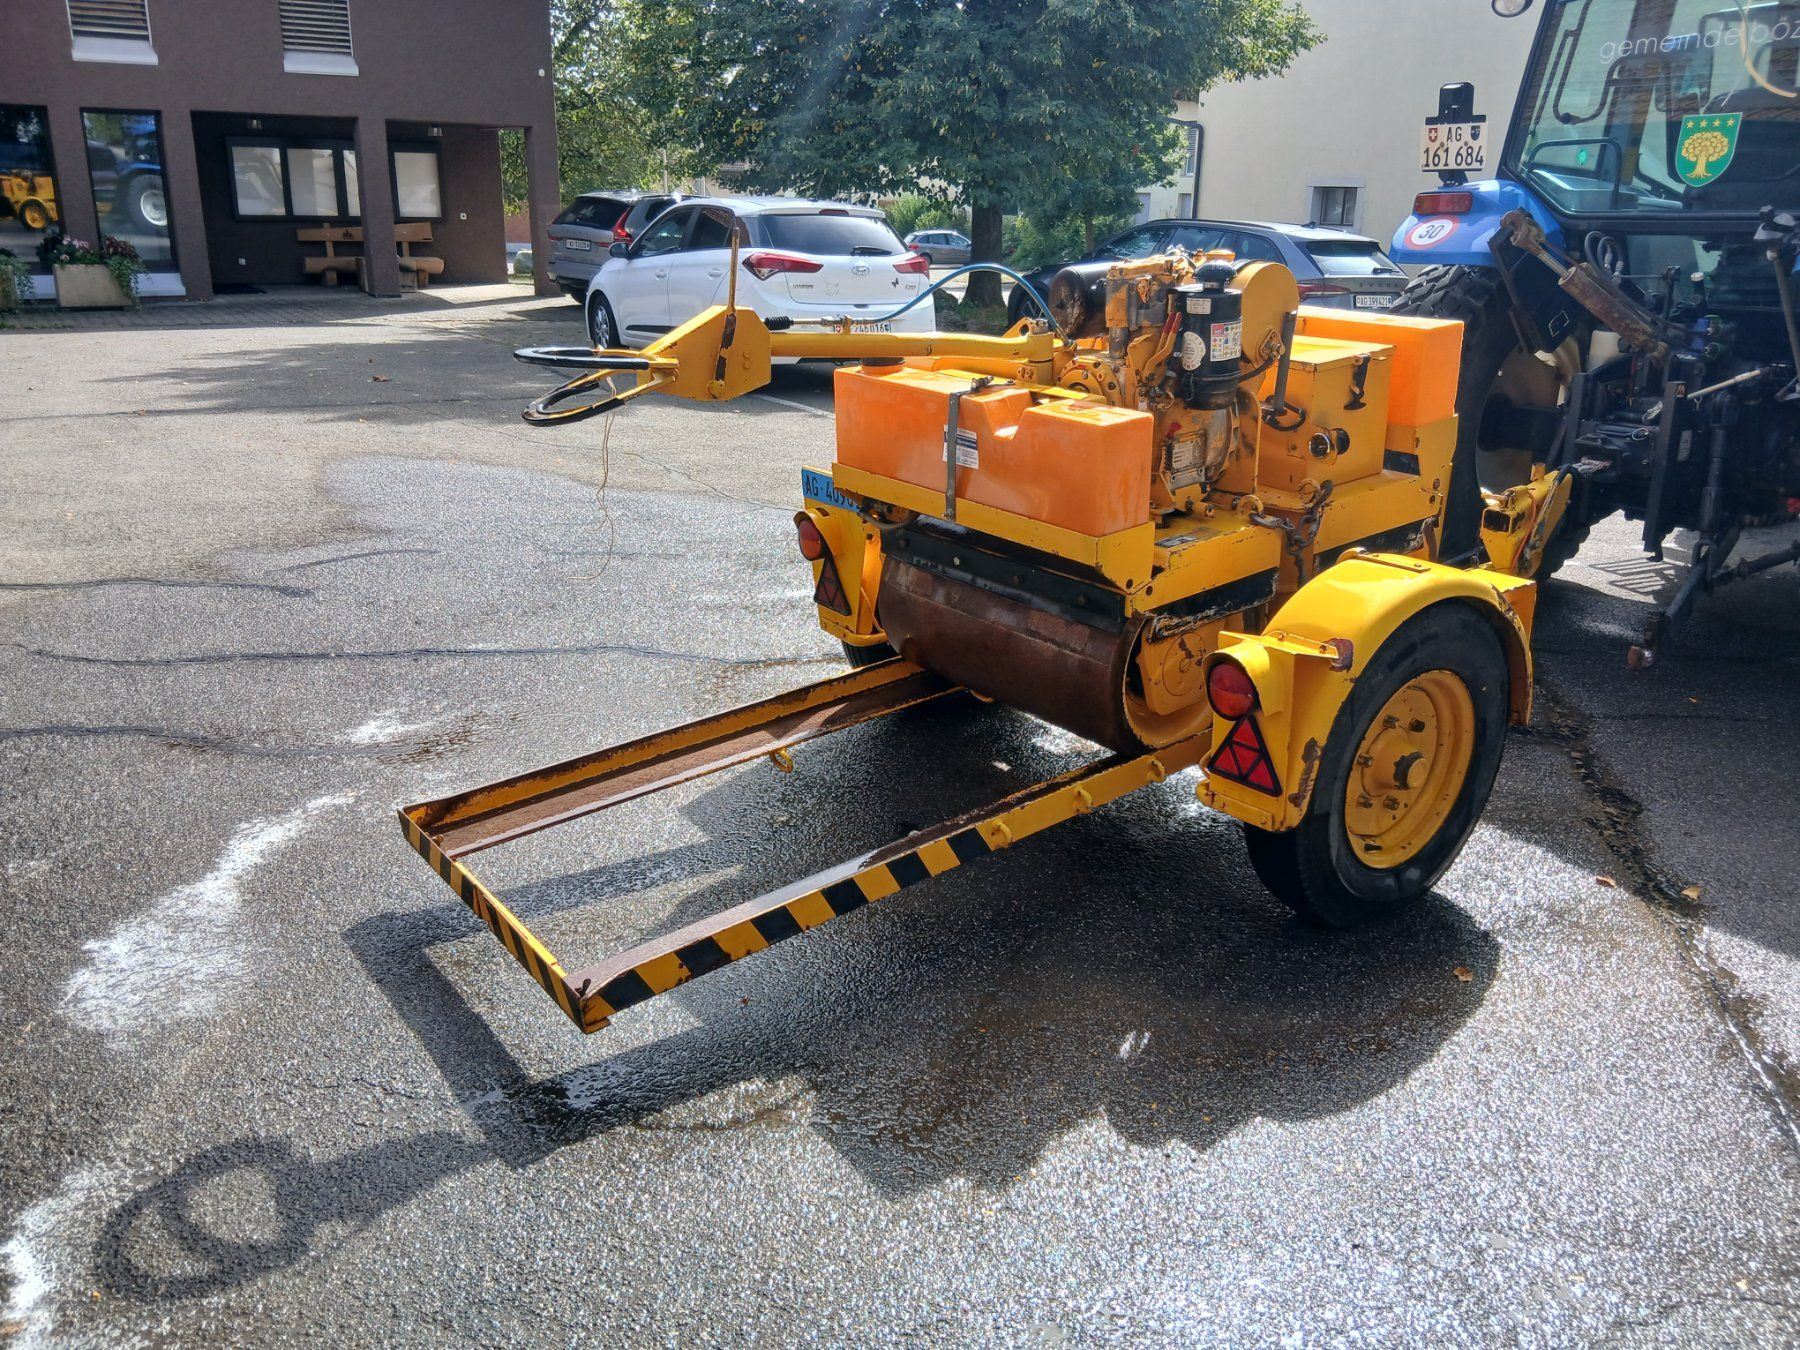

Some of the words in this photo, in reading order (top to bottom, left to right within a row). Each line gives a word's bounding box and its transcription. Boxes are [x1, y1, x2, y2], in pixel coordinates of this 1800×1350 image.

[1600, 24, 1740, 64] gemeinde
[1446, 126, 1462, 142] AG
[1419, 224, 1445, 239] 30
[805, 474, 819, 497] AG
